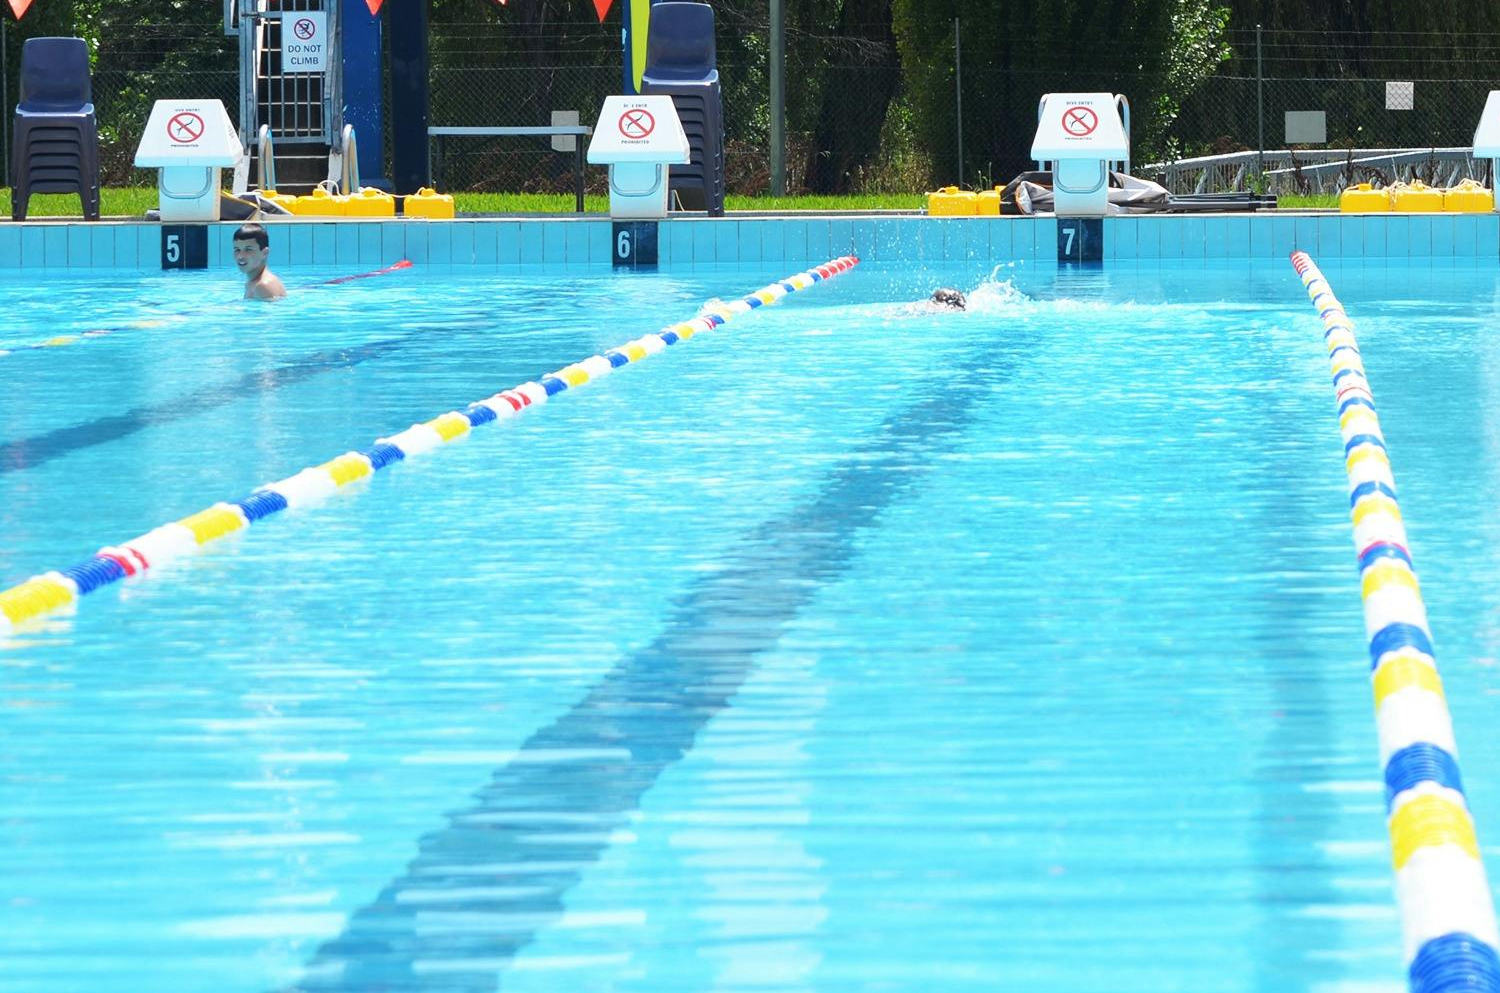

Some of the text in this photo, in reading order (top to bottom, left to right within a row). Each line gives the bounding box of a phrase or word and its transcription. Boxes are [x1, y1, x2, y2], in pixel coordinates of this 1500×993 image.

[288, 45, 321, 53] DO NOT
[290, 57, 319, 65] CLIMB
[166, 234, 180, 262] 5
[617, 230, 631, 258] 6
[1062, 228, 1076, 255] 7
